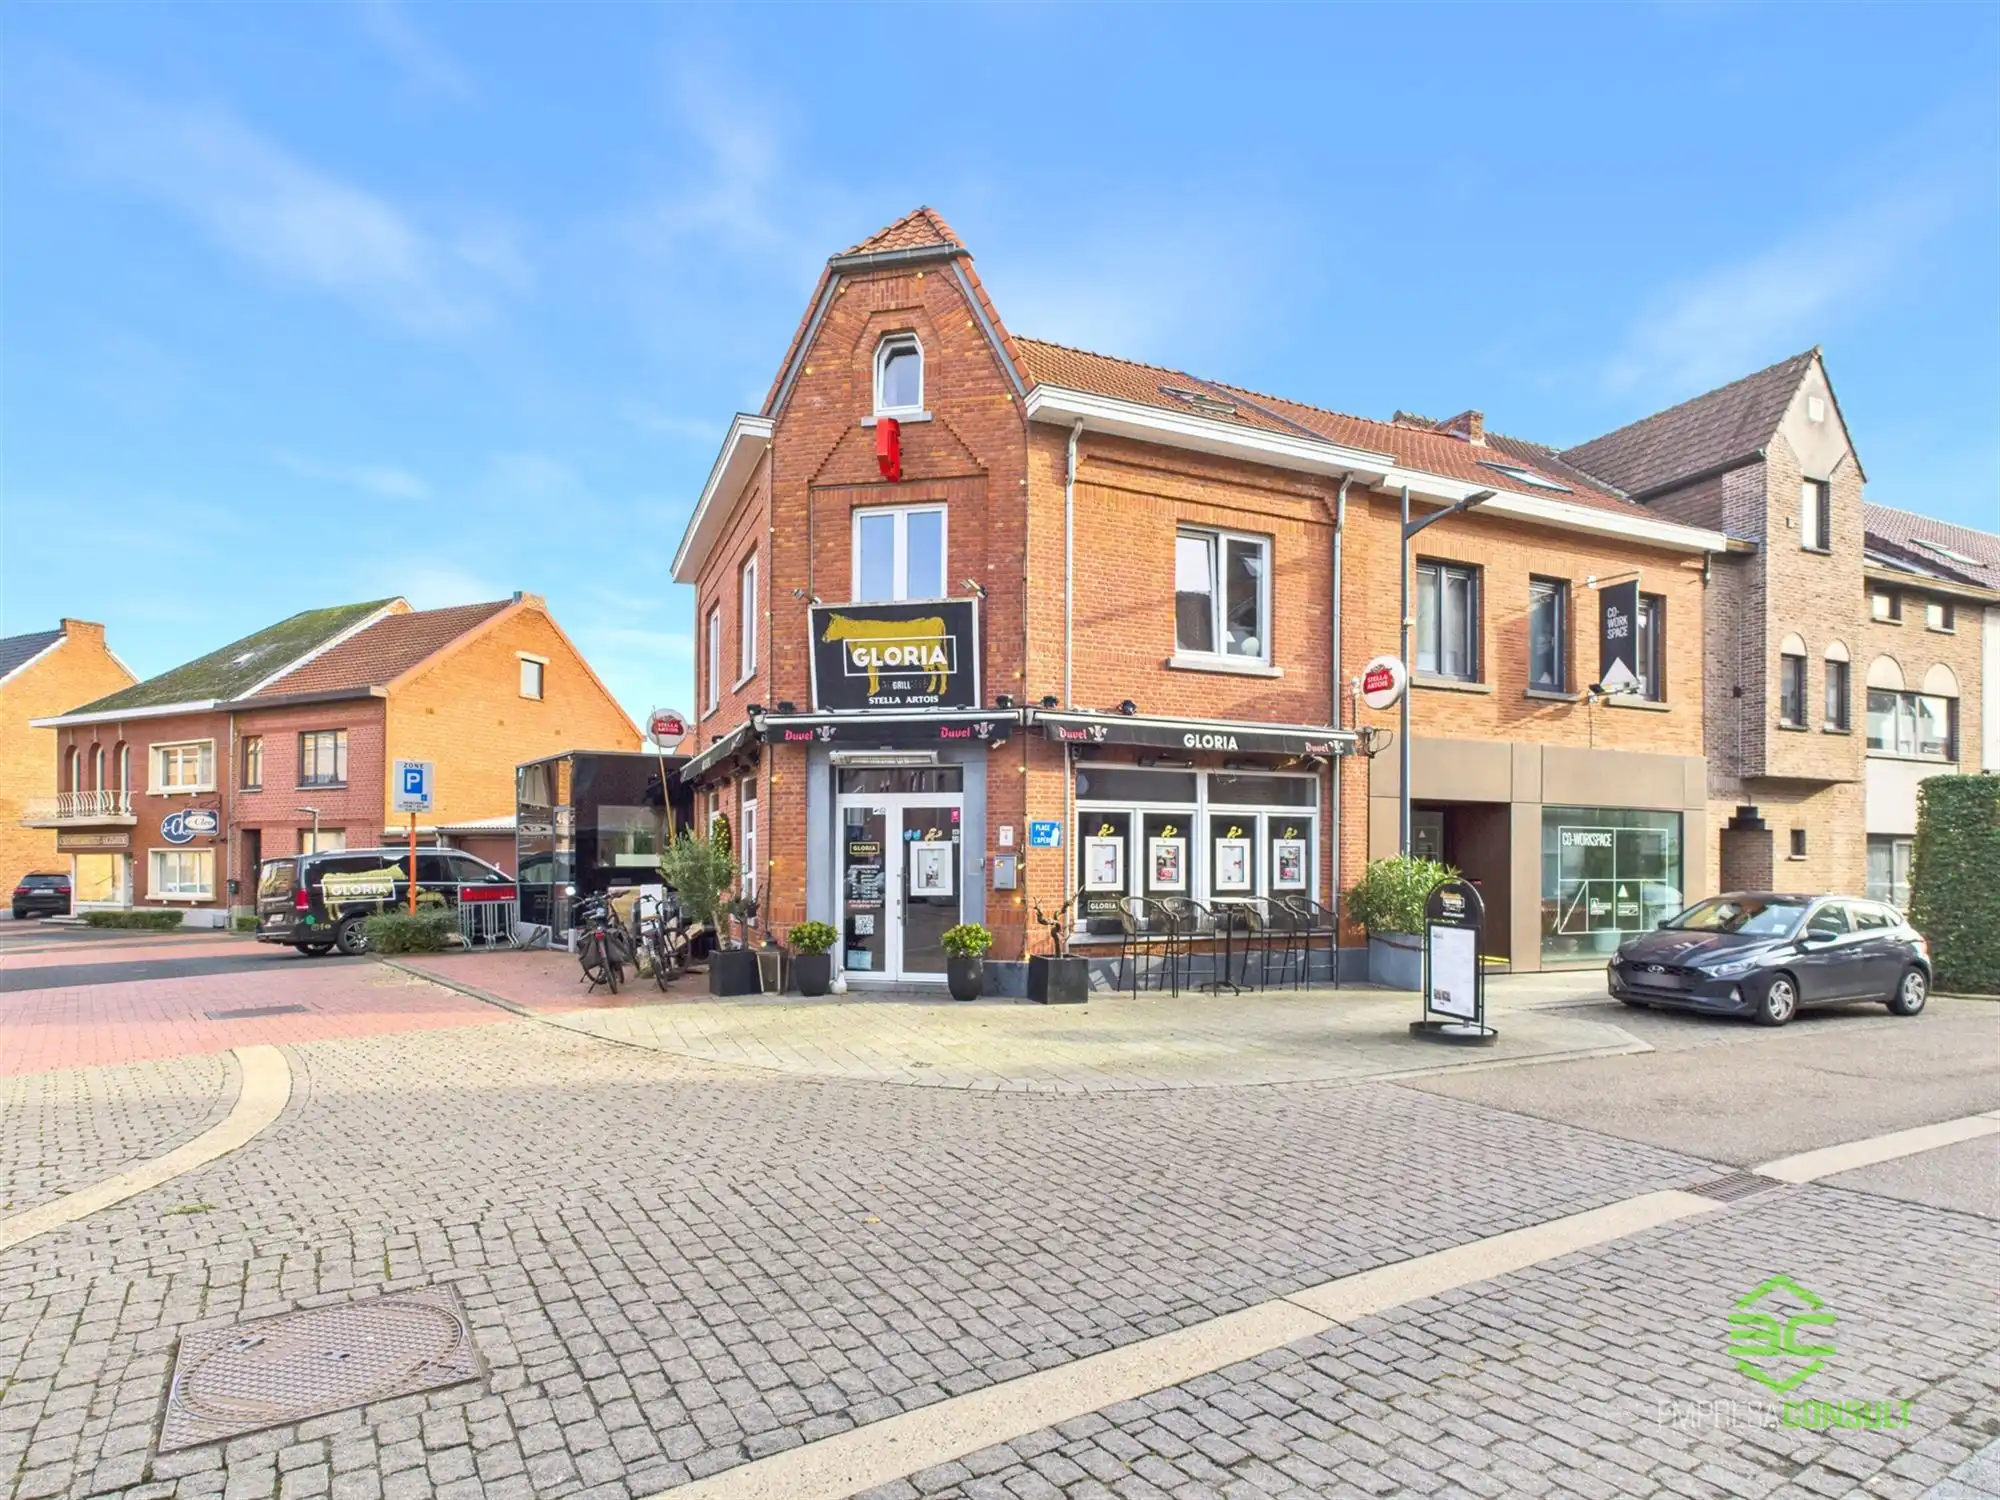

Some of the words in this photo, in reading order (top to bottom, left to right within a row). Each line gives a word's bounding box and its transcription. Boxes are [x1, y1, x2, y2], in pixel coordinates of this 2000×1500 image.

[1607, 615, 1628, 628] WORK
[1607, 626, 1628, 639] SPACE
[852, 646, 948, 667] GLORIA
[892, 680, 911, 690] GRILL
[868, 696, 901, 704] STELLA
[905, 695, 939, 704] ARTOIS
[784, 730, 813, 740] Duvel
[940, 726, 971, 738] Duvel
[1059, 726, 1087, 740] Duvel
[1183, 733, 1239, 750] GLORIA
[1305, 742, 1329, 753] Duvel
[406, 773, 420, 790] P
[1562, 832, 1612, 847] CO-WORKSPACE
[331, 884, 388, 896] GLORIA
[1090, 902, 1117, 910] GLORIA
